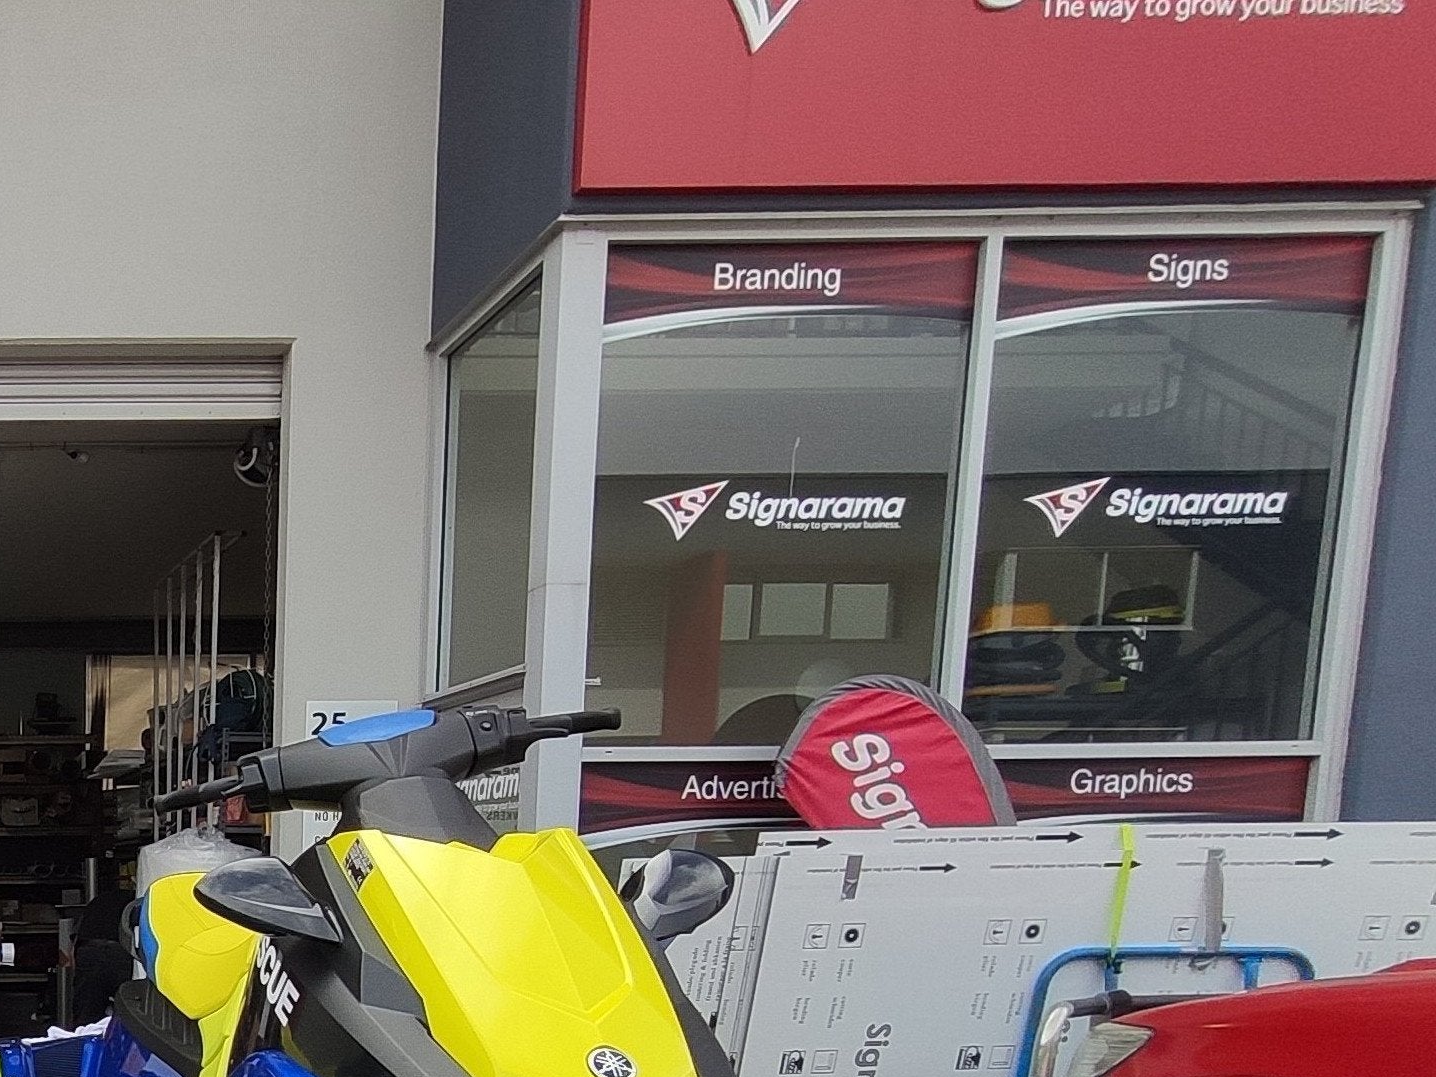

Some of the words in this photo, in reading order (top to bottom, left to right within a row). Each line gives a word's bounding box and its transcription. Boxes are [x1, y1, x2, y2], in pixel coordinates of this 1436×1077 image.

[1043, 0, 1083, 18] The
[1088, 0, 1135, 23] way
[1145, 0, 1171, 17] to
[1175, 0, 1237, 21] grow
[1239, 0, 1295, 21] your
[713, 262, 842, 296] Branding
[1147, 253, 1229, 289] Signs
[725, 491, 907, 527] Signarama
[1105, 487, 1289, 523] Signarama
[792, 521, 810, 532] way
[821, 522, 842, 532] grow
[1070, 768, 1194, 799] Graphics
